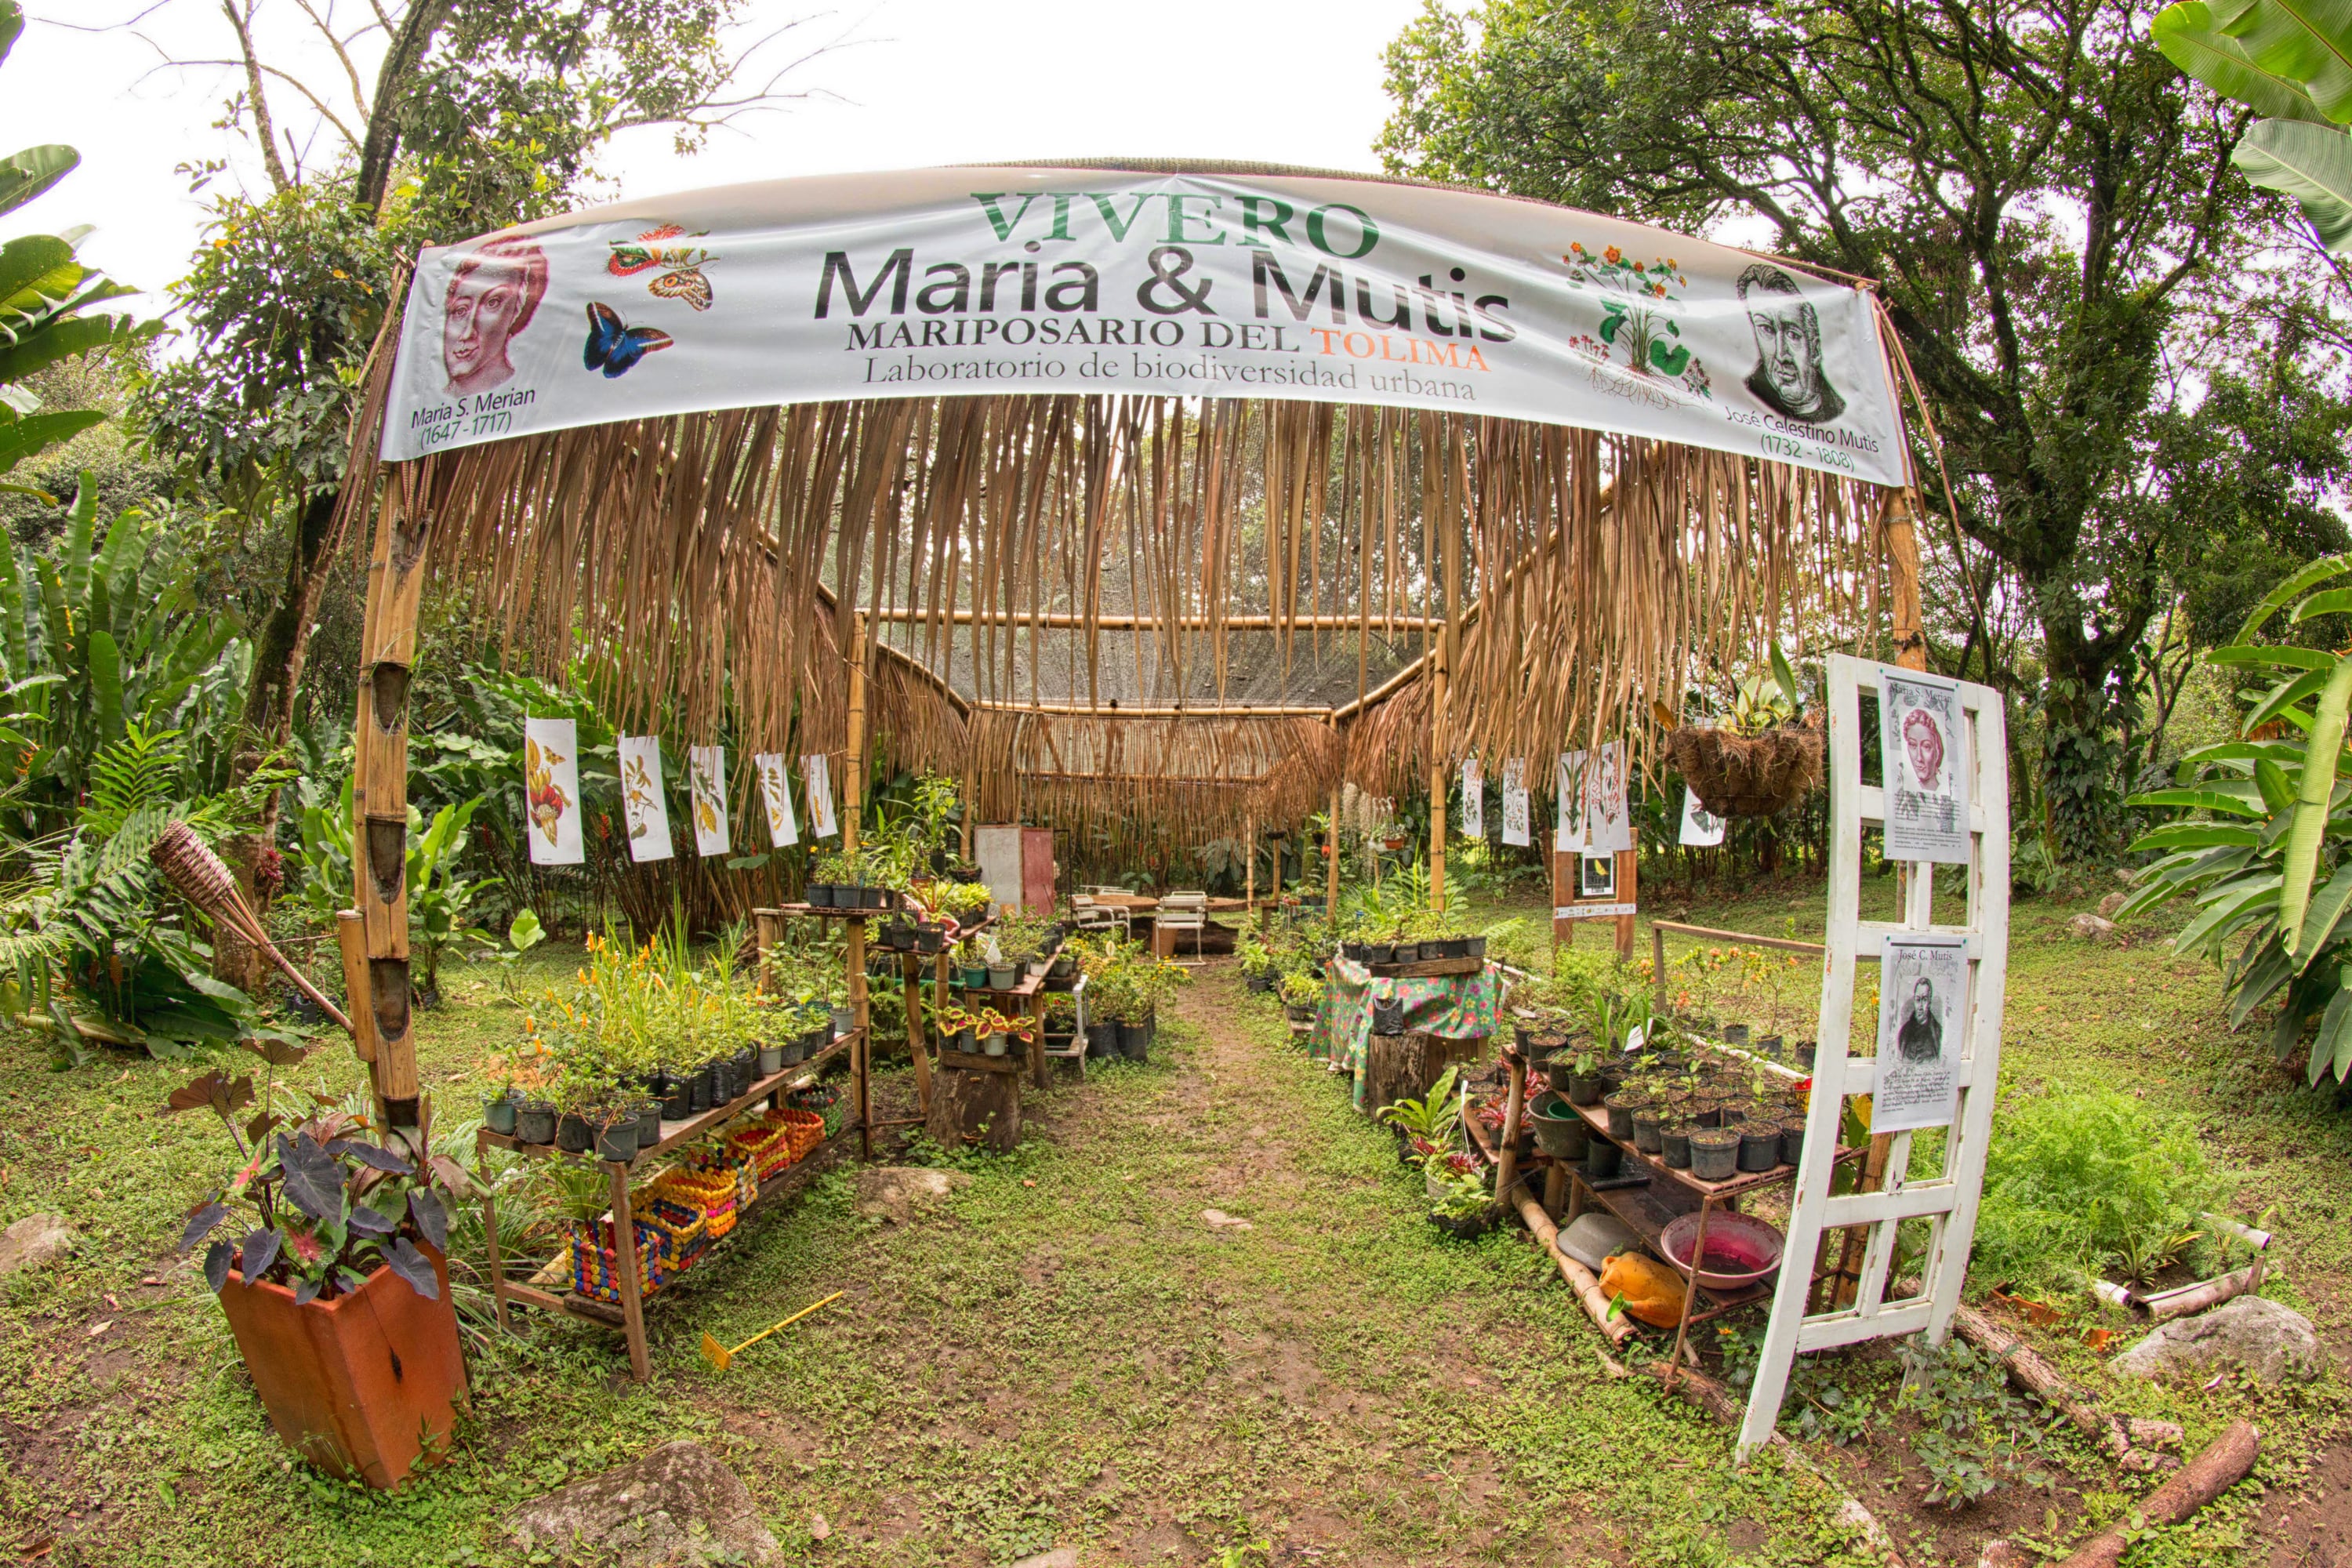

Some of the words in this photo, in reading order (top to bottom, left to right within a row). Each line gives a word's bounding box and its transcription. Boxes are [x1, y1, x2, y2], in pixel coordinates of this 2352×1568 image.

[970, 192, 1380, 259] VIVERO
[814, 241, 1099, 319] Maria
[1136, 245, 1219, 316] &
[1251, 250, 1517, 343] Mutis
[844, 318, 1185, 351] MARIPOSARIO
[1200, 321, 1300, 353] DEL
[1310, 327, 1492, 372] TOLIMA
[863, 352, 1066, 384] Laboratorio
[1079, 351, 1120, 378] de
[1133, 351, 1356, 390] biodiversidad
[1369, 369, 1477, 401] urbana
[411, 402, 452, 429] Maria
[456, 397, 470, 418] S.
[474, 387, 536, 414] Merian
[1725, 406, 1762, 427] José
[1764, 414, 1835, 444] Celestino
[1839, 428, 1879, 453] Mutis
[419, 421, 461, 450] (1647
[472, 412, 512, 437] 1717)
[1761, 434, 1802, 459] (1732
[1816, 446, 1855, 472] 1808)
[1889, 682, 1914, 695] Maria
[1915, 687, 1924, 697] S.
[1925, 689, 1952, 703] Merian
[1898, 949, 1917, 963] José
[1918, 949, 1928, 960] C.
[1930, 949, 1953, 960] Mutis
